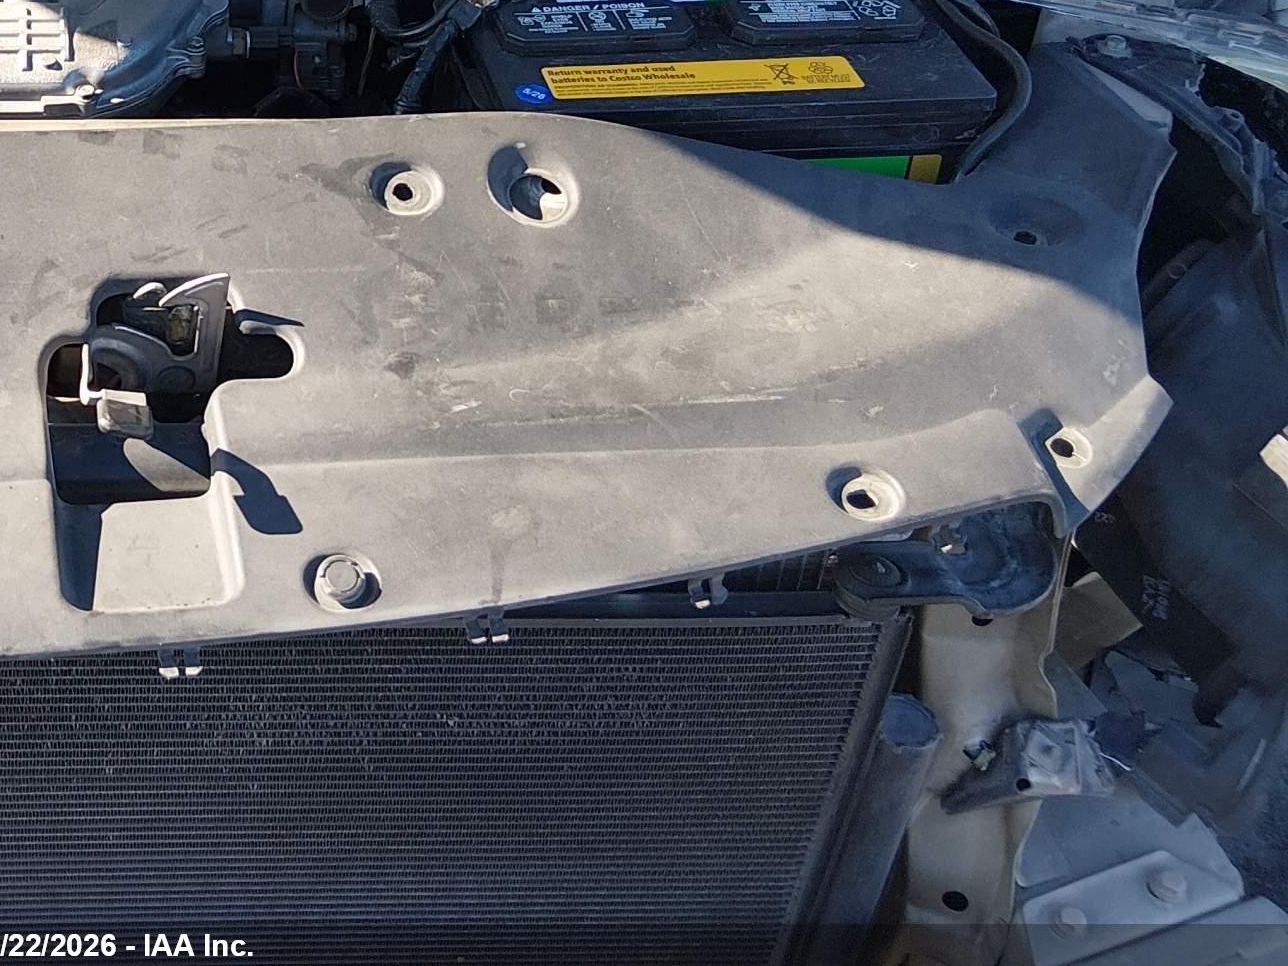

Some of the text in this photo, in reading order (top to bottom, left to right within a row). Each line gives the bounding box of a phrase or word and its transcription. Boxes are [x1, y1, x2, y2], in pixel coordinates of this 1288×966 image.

[542, 4, 590, 13] DANGER
[602, 2, 645, 10] POISON
[547, 68, 582, 77] Return
[583, 67, 628, 77] warranty
[630, 65, 650, 73] and
[550, 75, 595, 84] batteries
[643, 72, 696, 80] Wholesale
